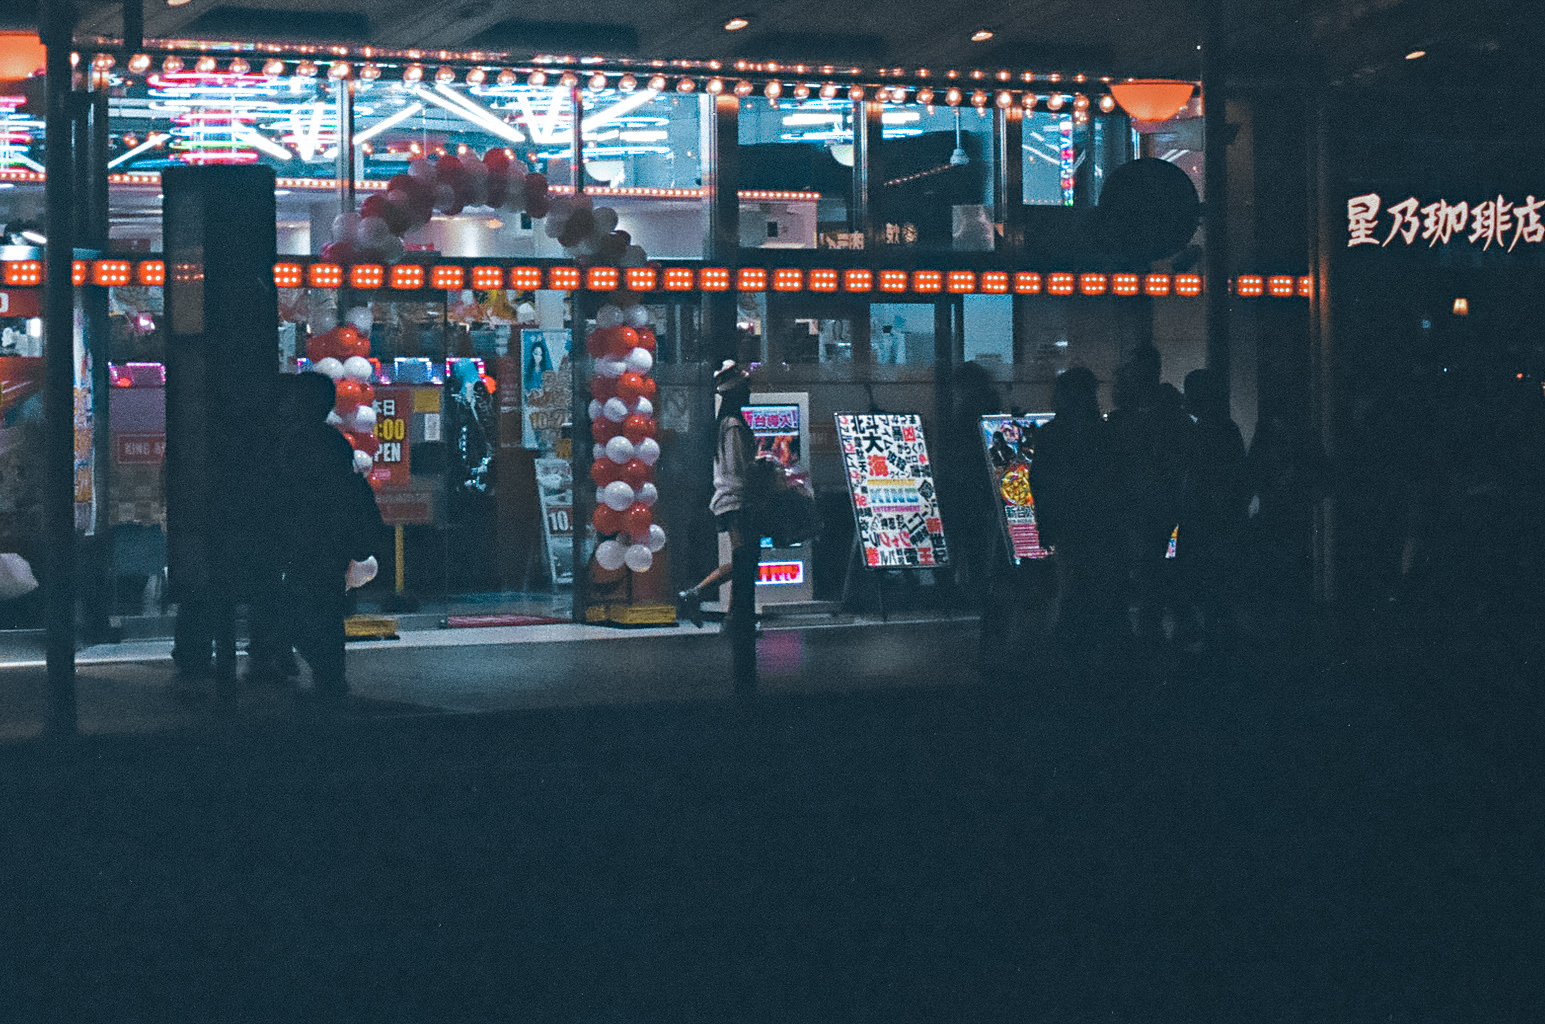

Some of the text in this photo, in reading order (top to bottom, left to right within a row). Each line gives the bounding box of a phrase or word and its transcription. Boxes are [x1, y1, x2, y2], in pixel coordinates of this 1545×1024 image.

[1347, 191, 1545, 254] 星乃珈琲店
